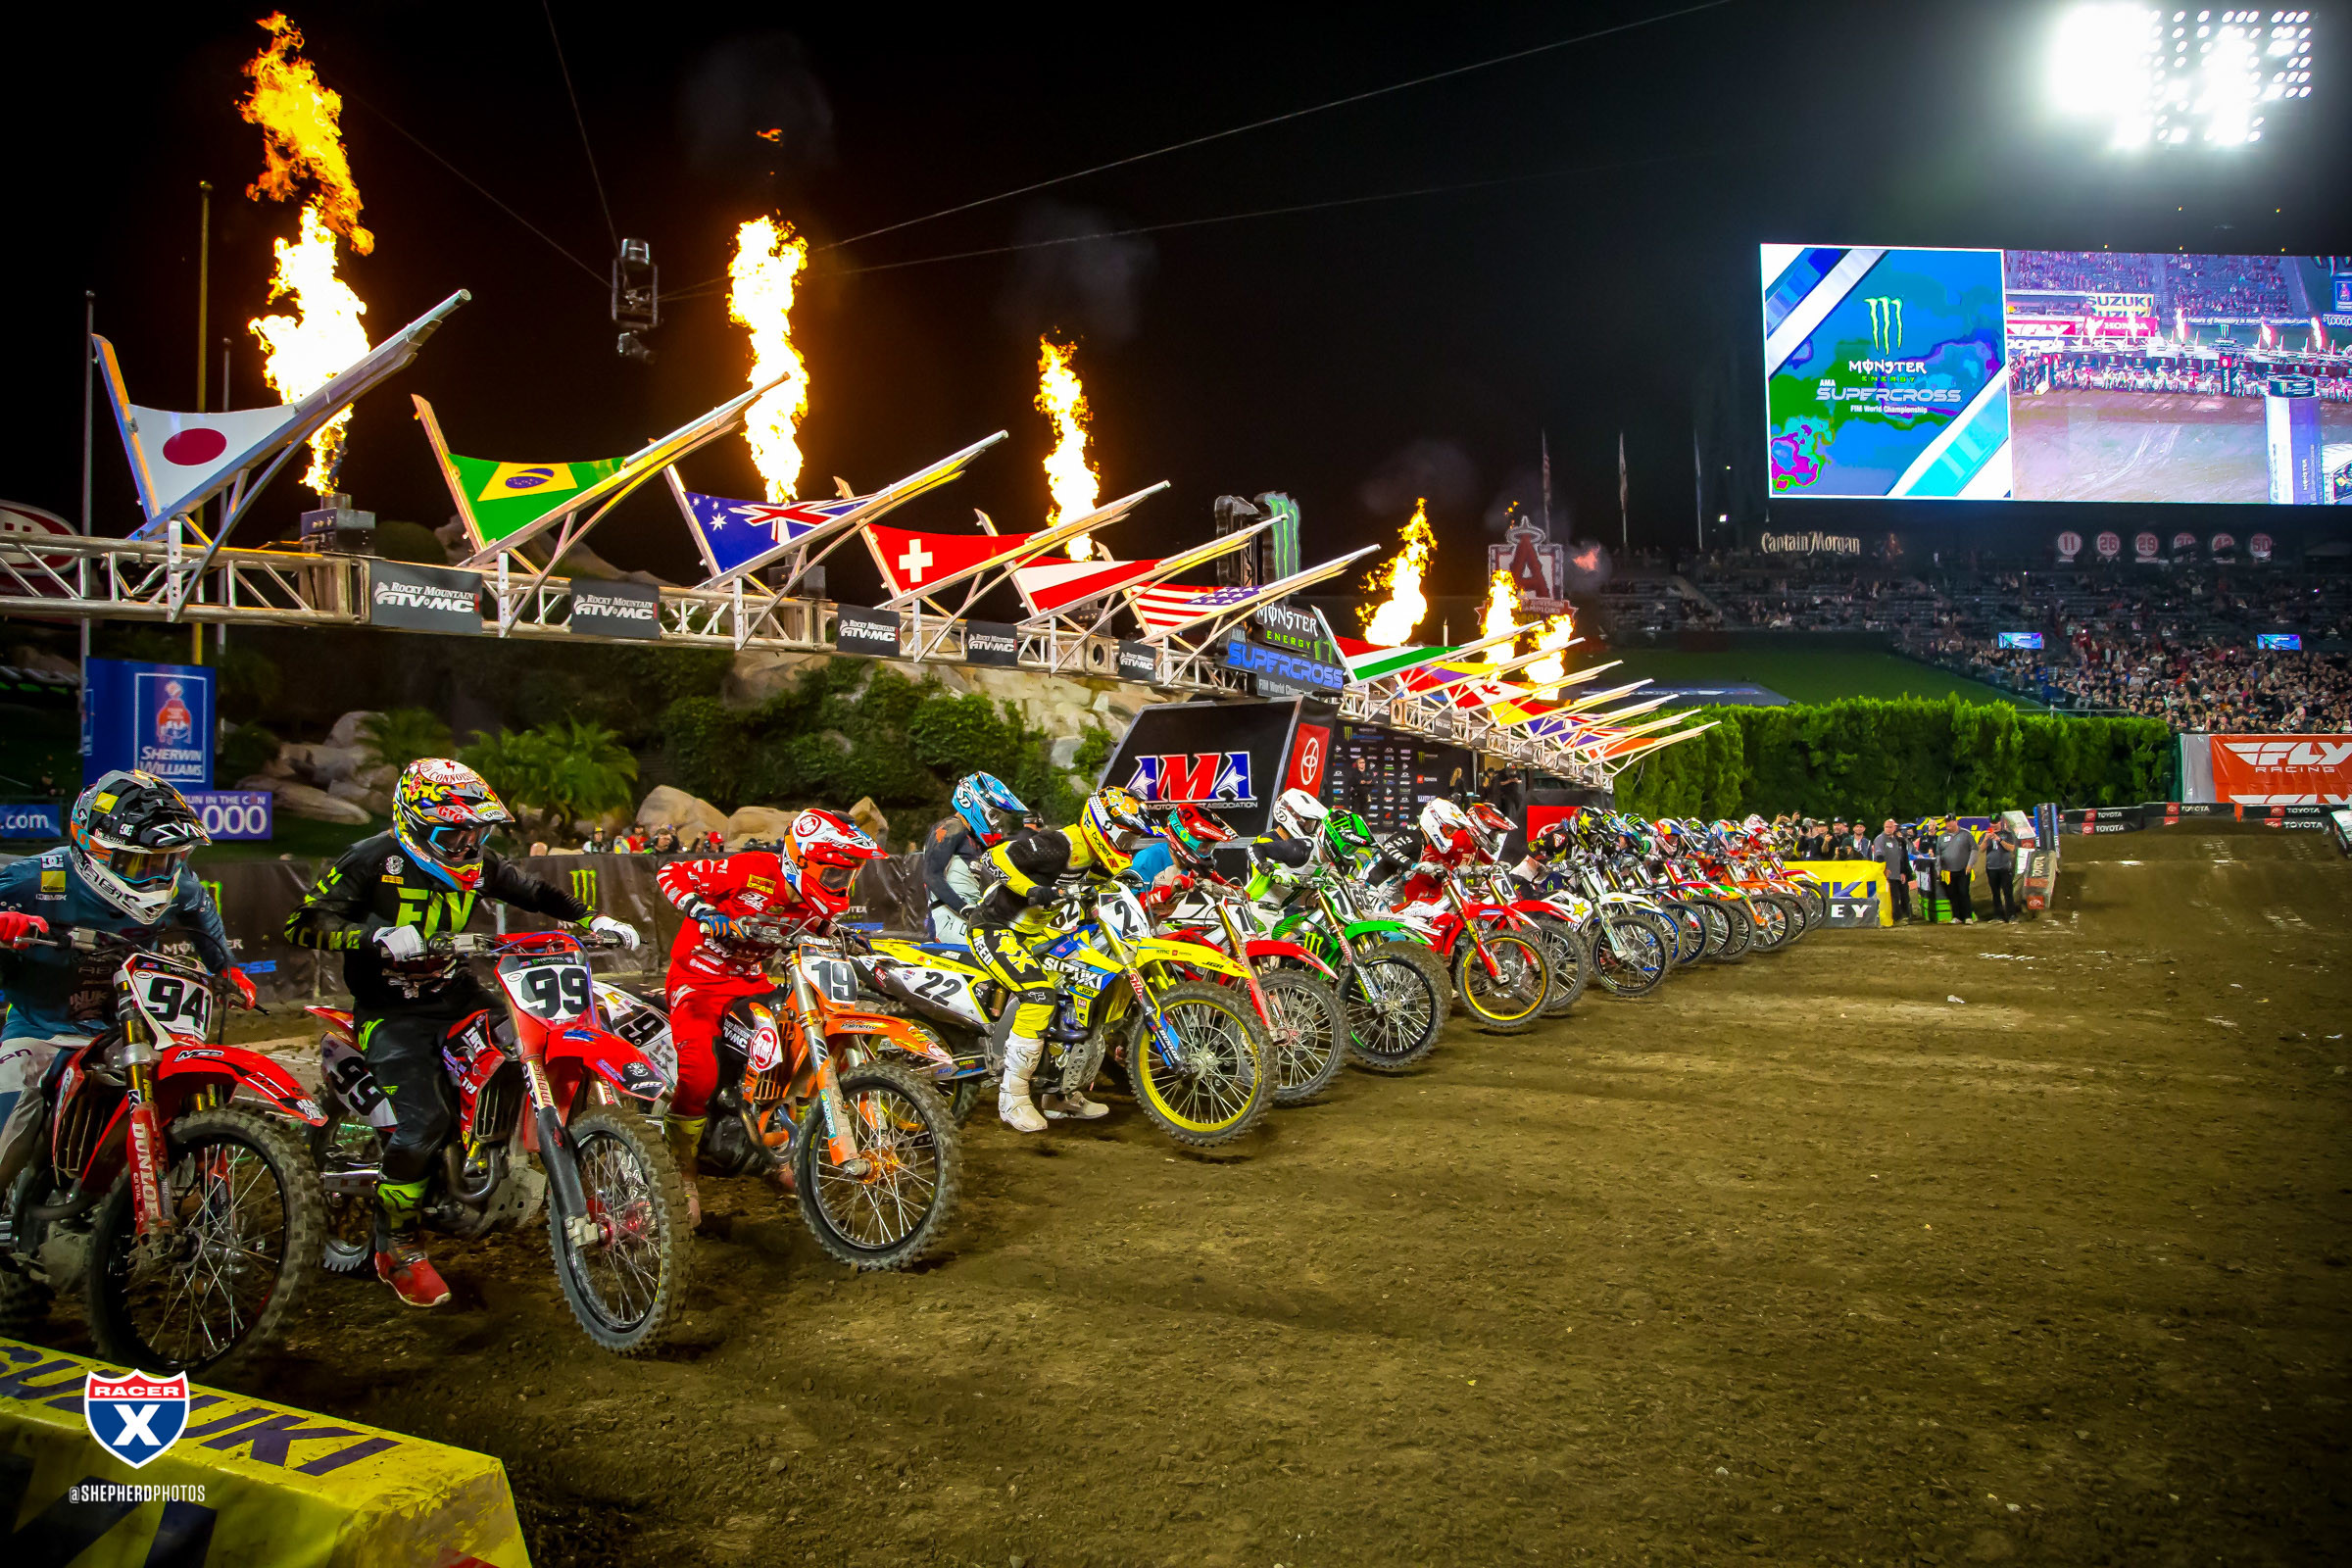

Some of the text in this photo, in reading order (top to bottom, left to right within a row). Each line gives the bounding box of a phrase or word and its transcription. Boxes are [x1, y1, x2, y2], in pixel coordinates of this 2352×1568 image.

[1848, 359, 1928, 374] MONSTER
[1815, 386, 1962, 403] SUPERCROSS
[1883, 406, 1928, 415] Championship
[1762, 530, 1861, 556] Captain Morgan
[391, 581, 474, 601] ROCKY MOUNTAIN
[587, 594, 655, 609] ROCKY MOUNTAIN
[1256, 602, 1319, 638] MONSTER
[1266, 629, 1311, 650] ENERGY
[1227, 641, 1344, 690] SUPERCROSS
[140, 746, 203, 761] SHERWIN
[140, 760, 203, 777] WILLIAMS
[1126, 751, 1258, 803] AMA
[219, 796, 241, 805] THE
[2097, 810, 2123, 819] TOYOTA
[2095, 823, 2125, 833] TOYOTA
[2283, 820, 2324, 830] TOYOTA
[972, 936, 995, 966] REED
[810, 962, 858, 1003] 19
[1043, 956, 1103, 992] SUZUKI
[520, 966, 591, 1019] 99
[913, 970, 962, 1007] 22
[1078, 986, 1096, 997] JGR
[824, 1095, 837, 1137] MOTOREX
